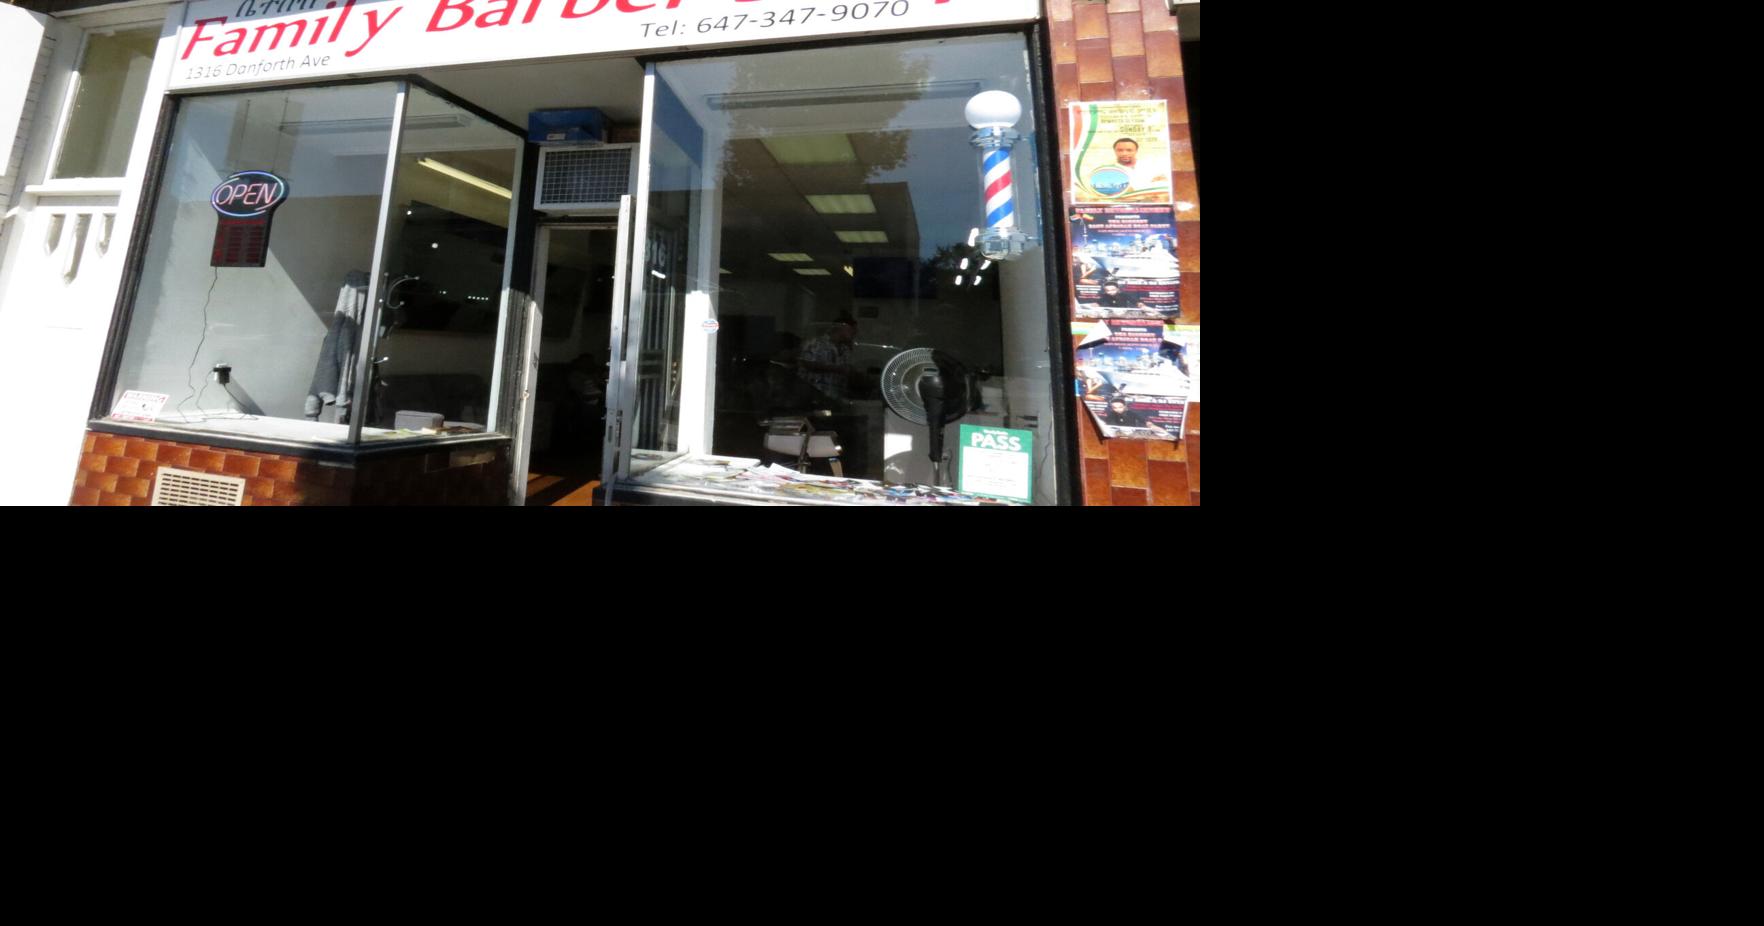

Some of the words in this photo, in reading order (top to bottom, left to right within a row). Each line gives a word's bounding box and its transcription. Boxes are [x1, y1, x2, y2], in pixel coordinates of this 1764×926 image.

[181, 0, 404, 60] Family
[640, 20, 686, 39] Tel:
[697, 0, 909, 35] 647-347-9070
[185, 59, 222, 80] 1316
[226, 54, 295, 77] Danforth
[300, 53, 331, 69] Ave
[216, 183, 276, 205] OPEN
[971, 431, 1022, 451] PASS
